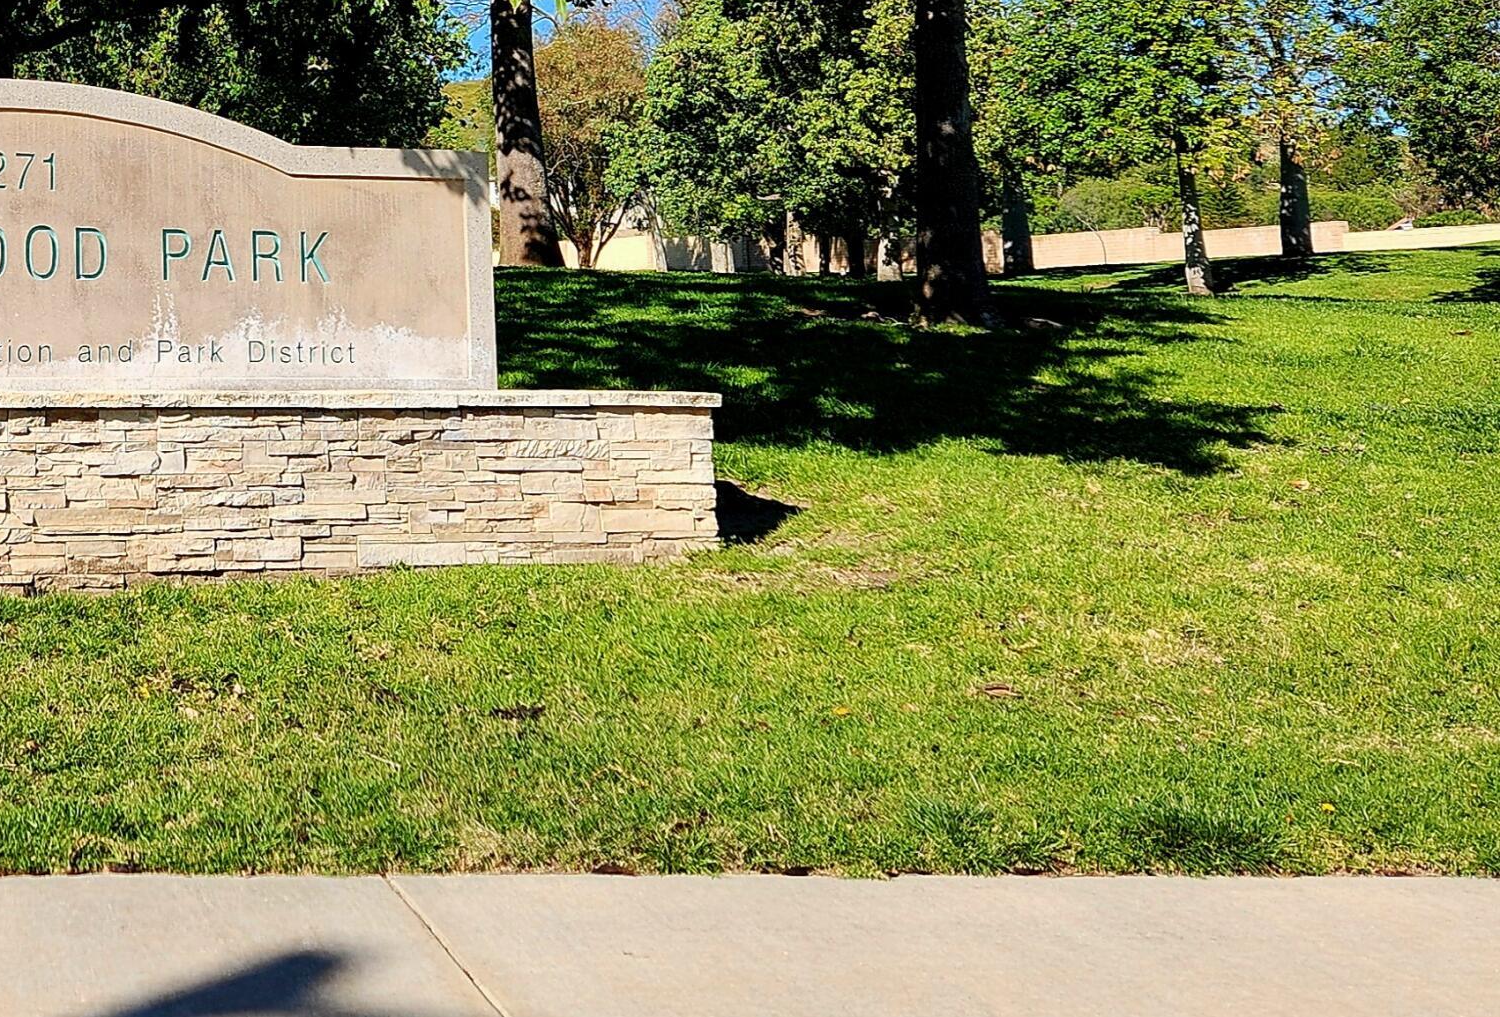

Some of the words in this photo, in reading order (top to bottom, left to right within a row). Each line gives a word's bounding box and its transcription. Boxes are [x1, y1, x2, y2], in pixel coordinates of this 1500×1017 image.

[160, 228, 331, 284] PARK
[77, 339, 133, 364] and
[156, 339, 224, 364] Park
[247, 339, 356, 365] District
